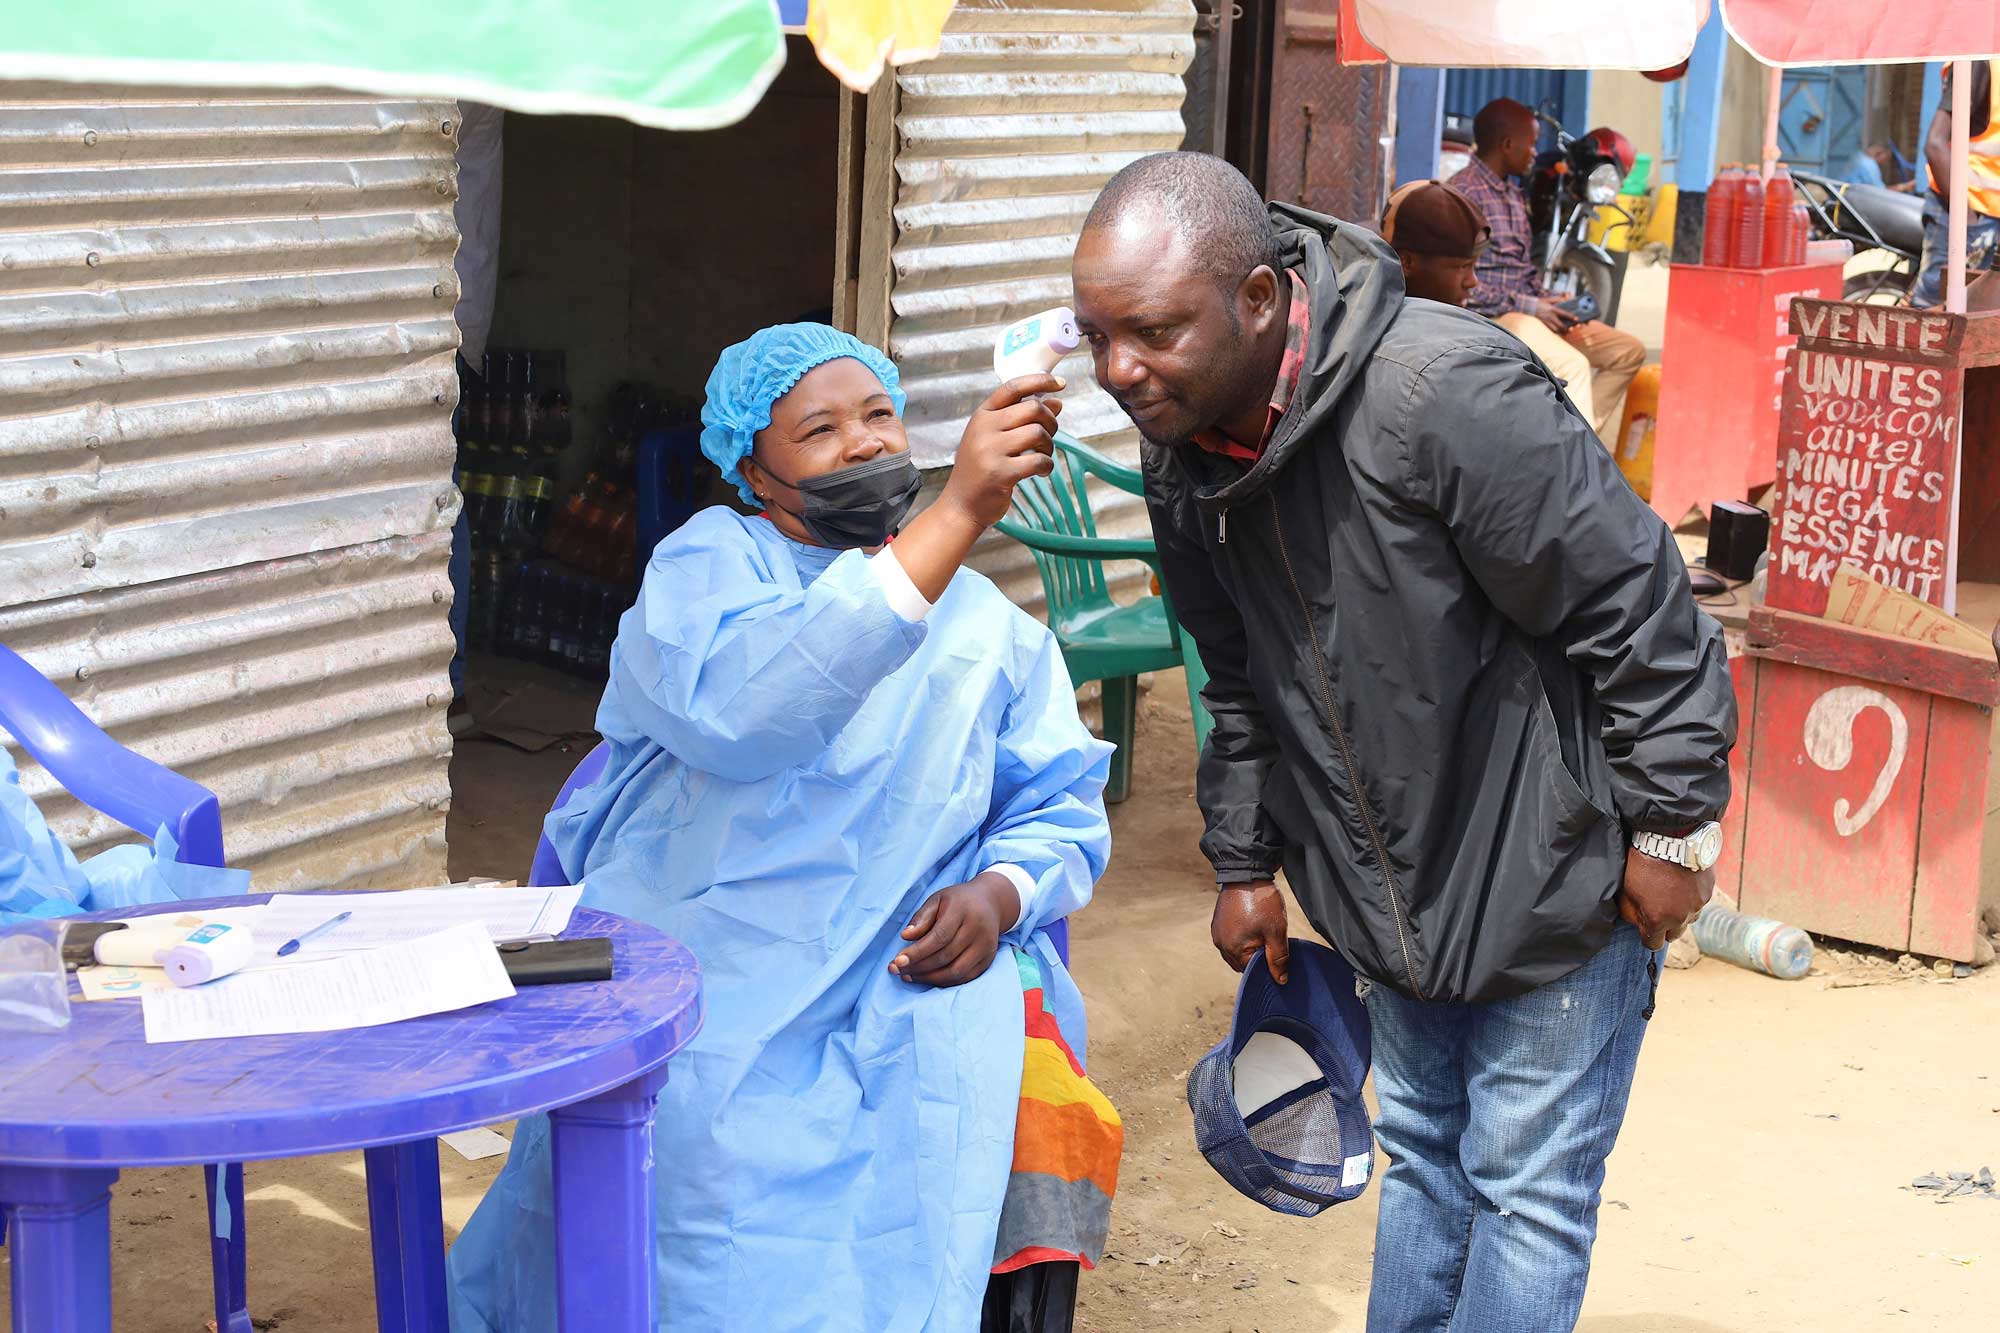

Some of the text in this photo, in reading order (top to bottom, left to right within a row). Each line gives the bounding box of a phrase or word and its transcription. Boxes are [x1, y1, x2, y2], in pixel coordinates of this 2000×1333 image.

[1795, 303, 1951, 356] VENTE
[1798, 351, 1942, 408] UNITES
[1806, 424, 1924, 466] airtel
[1786, 448, 1944, 503] MINUTES
[1784, 481, 1892, 527] MEGA
[1781, 509, 1944, 572] ESSENCE
